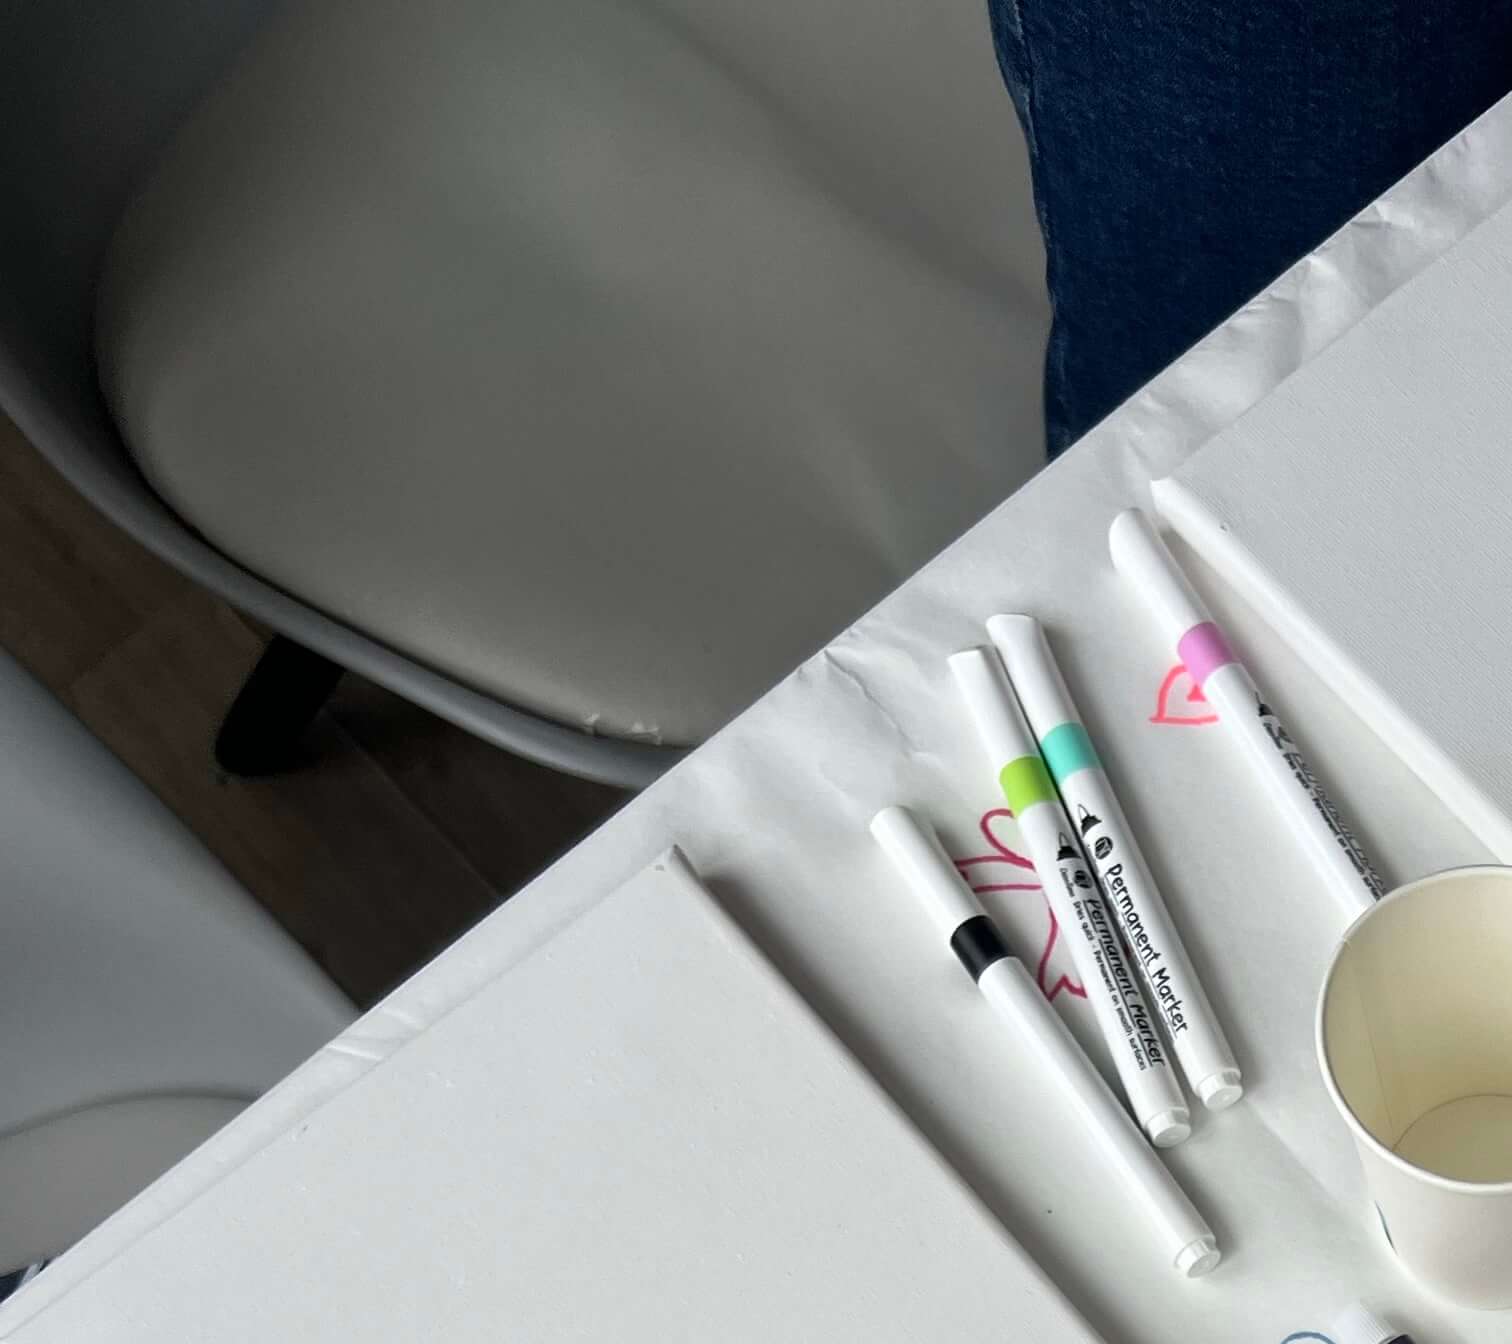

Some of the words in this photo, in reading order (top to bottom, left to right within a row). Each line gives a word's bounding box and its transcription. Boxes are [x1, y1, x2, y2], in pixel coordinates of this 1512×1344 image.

[1085, 895, 1140, 1000] Permanent
[1128, 1000, 1168, 1068] Marker
[1103, 862, 1162, 964] Permanent
[1150, 966, 1193, 1033] Marker
